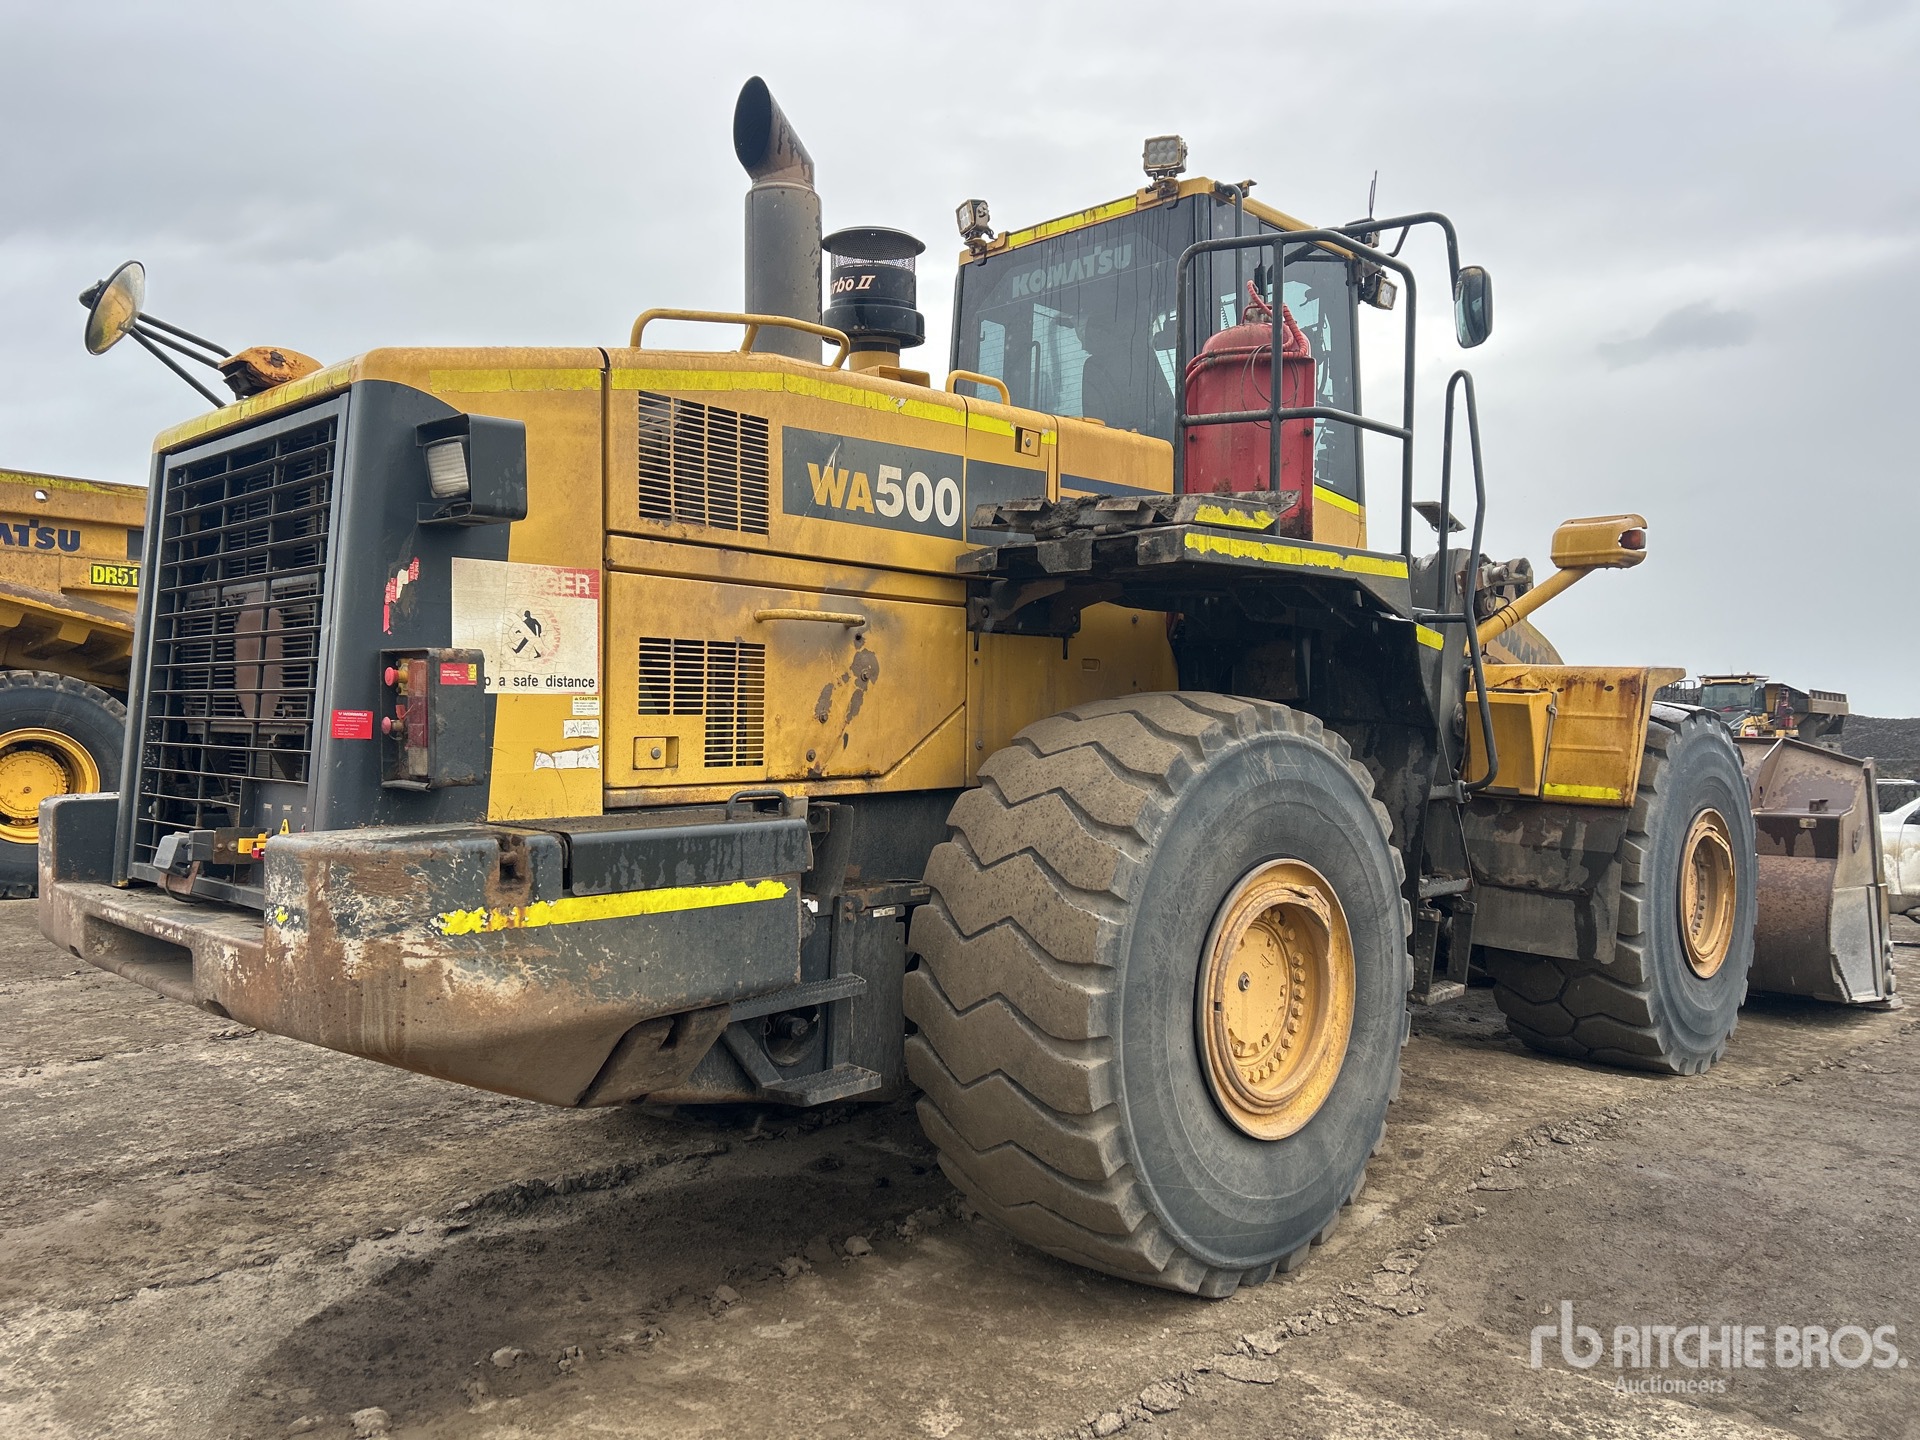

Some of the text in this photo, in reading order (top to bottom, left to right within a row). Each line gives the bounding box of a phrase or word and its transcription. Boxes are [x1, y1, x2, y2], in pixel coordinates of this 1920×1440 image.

[1012, 244, 1132, 299] KOMATSU
[806, 462, 961, 527] WA500
[498, 676, 506, 687] a
[513, 675, 539, 687] safe
[545, 674, 595, 688] distance
